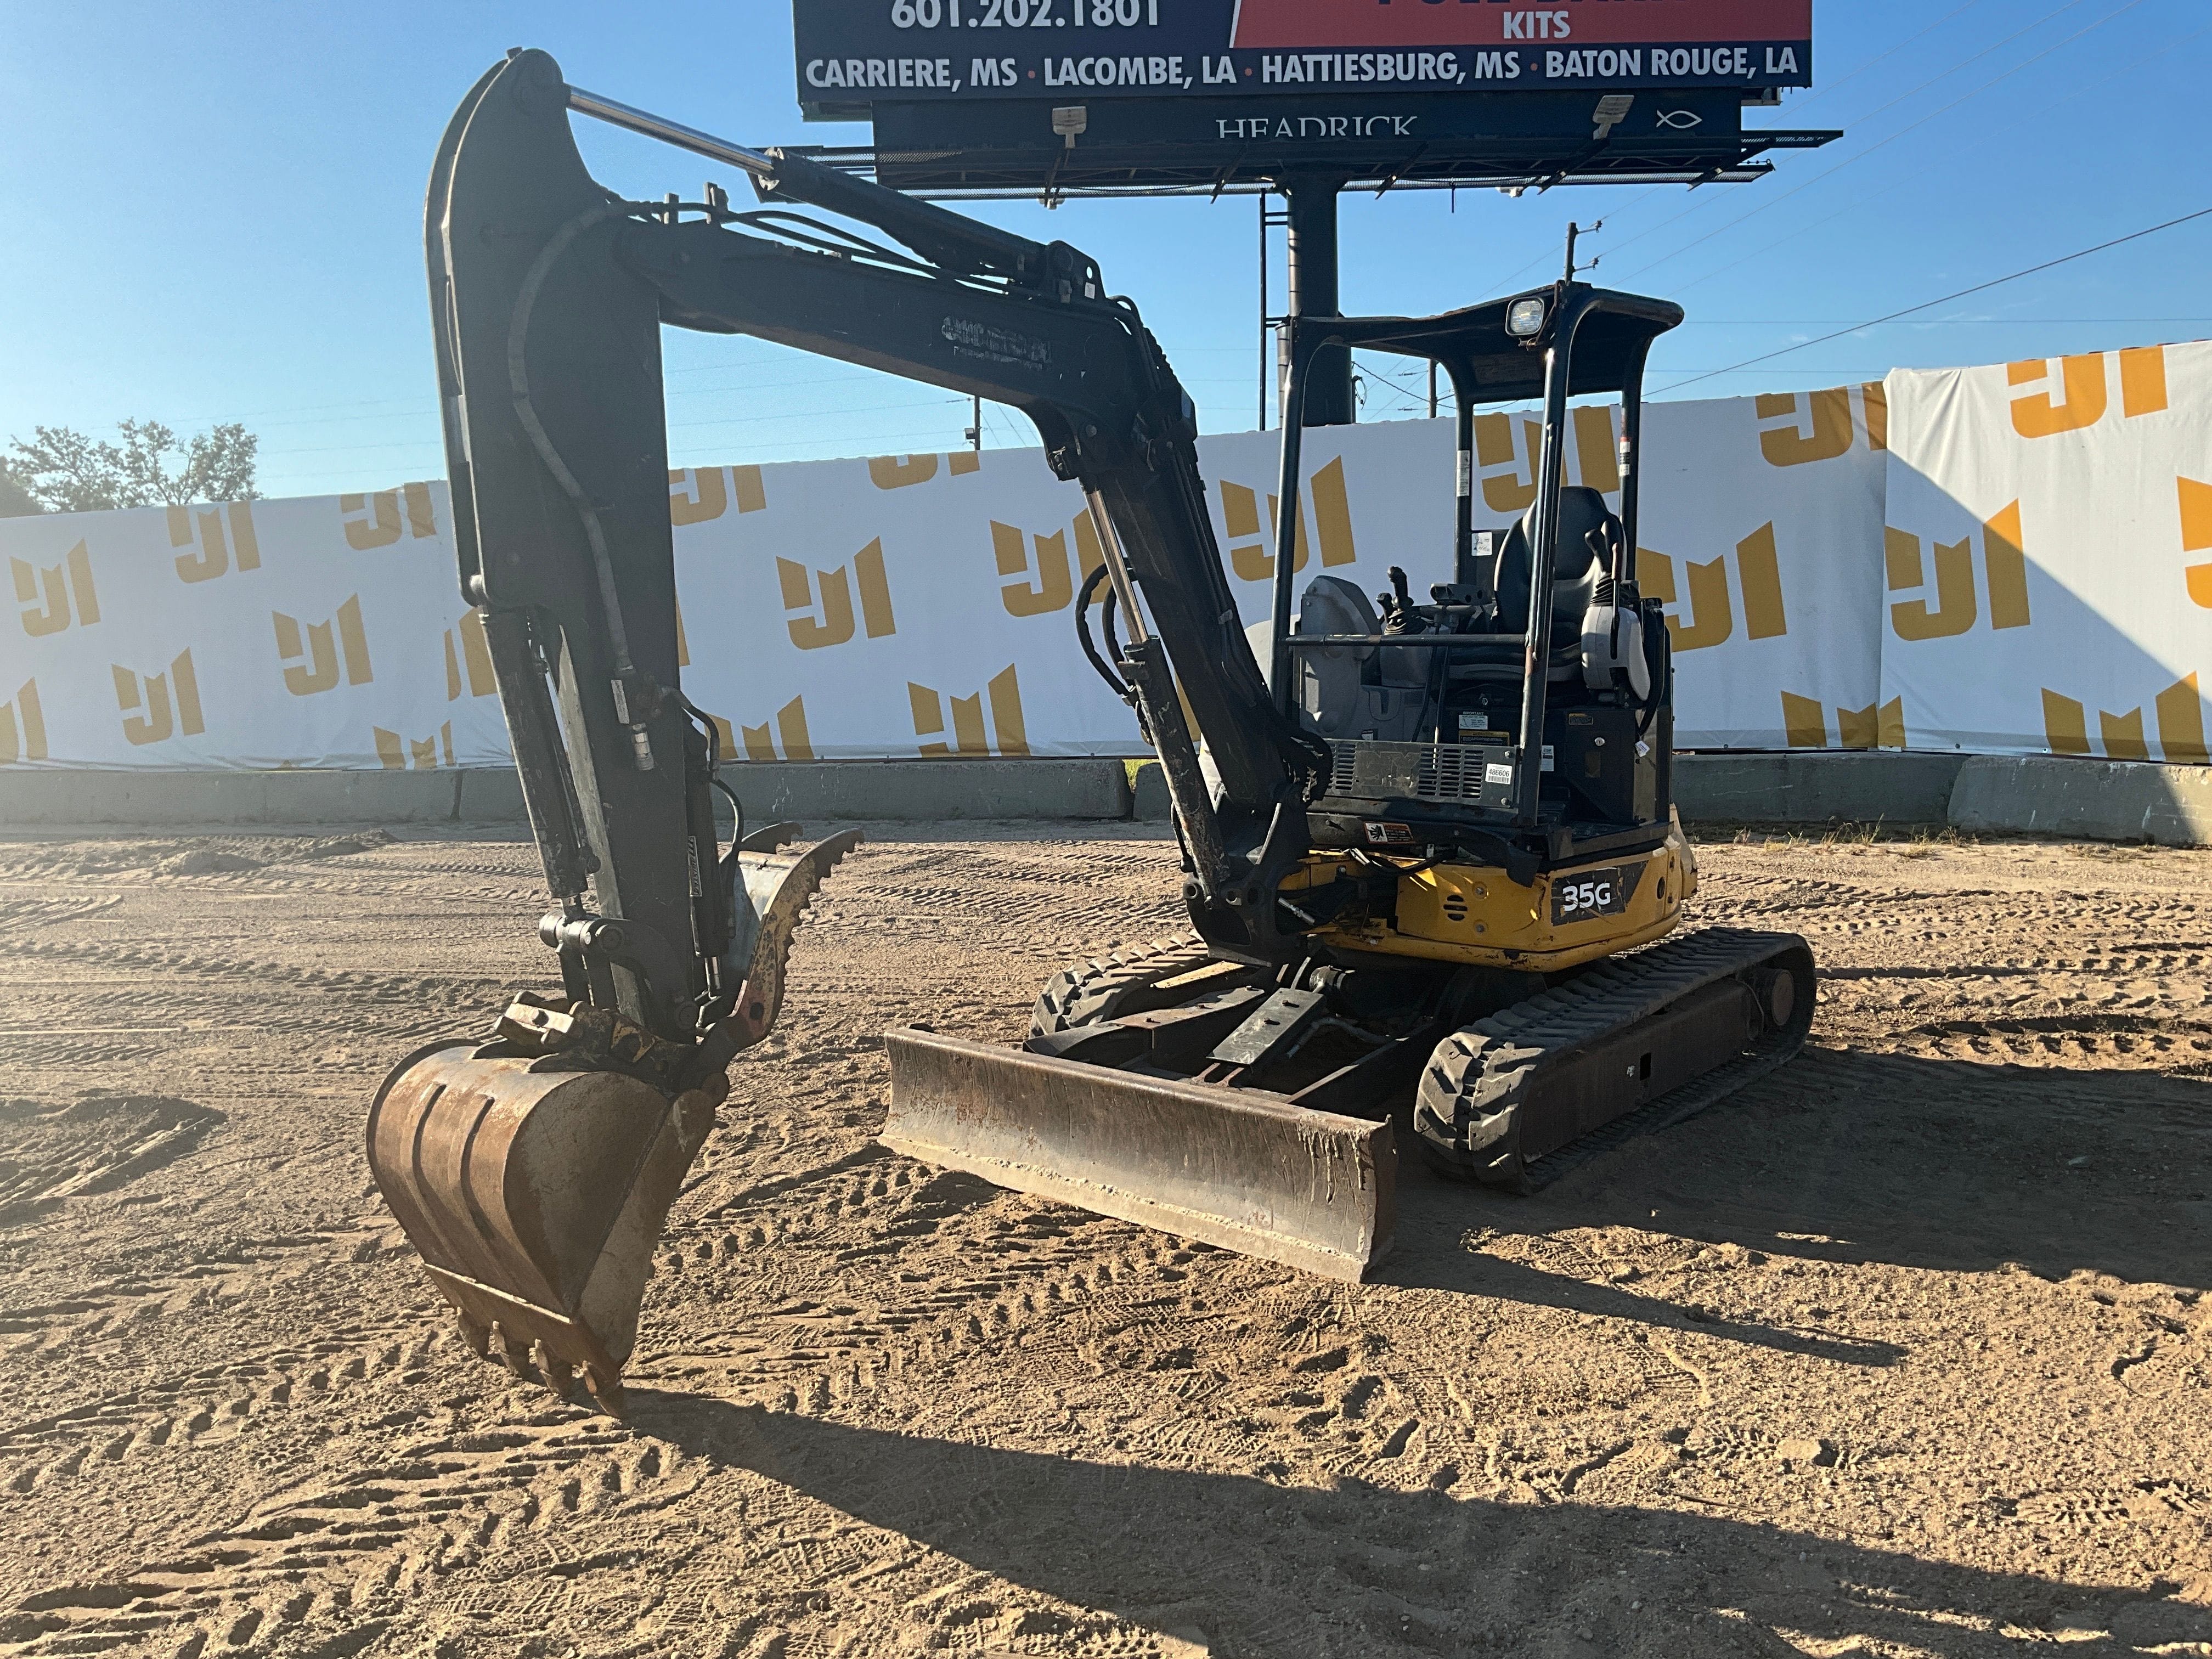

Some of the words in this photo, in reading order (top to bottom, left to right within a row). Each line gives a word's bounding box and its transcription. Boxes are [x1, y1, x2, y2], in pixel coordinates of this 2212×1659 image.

[891, 0, 1159, 28] 601.202.1801
[1503, 11, 1571, 39] KITS
[806, 59, 961, 92] CARRIERE,
[970, 59, 1017, 86] MS
[1045, 57, 1193, 90] LACOMBE,
[1202, 56, 1237, 83] LA
[1262, 52, 1466, 84] HATTIESBURG,
[1475, 52, 1520, 78] MS
[1546, 49, 1641, 77] BATON
[1651, 47, 1756, 78] ROUGE,
[1765, 47, 1798, 74] LA
[1215, 116, 1418, 138] HEADRICK
[1488, 768, 1510, 777] 486606
[1562, 882, 1611, 911] 35G
